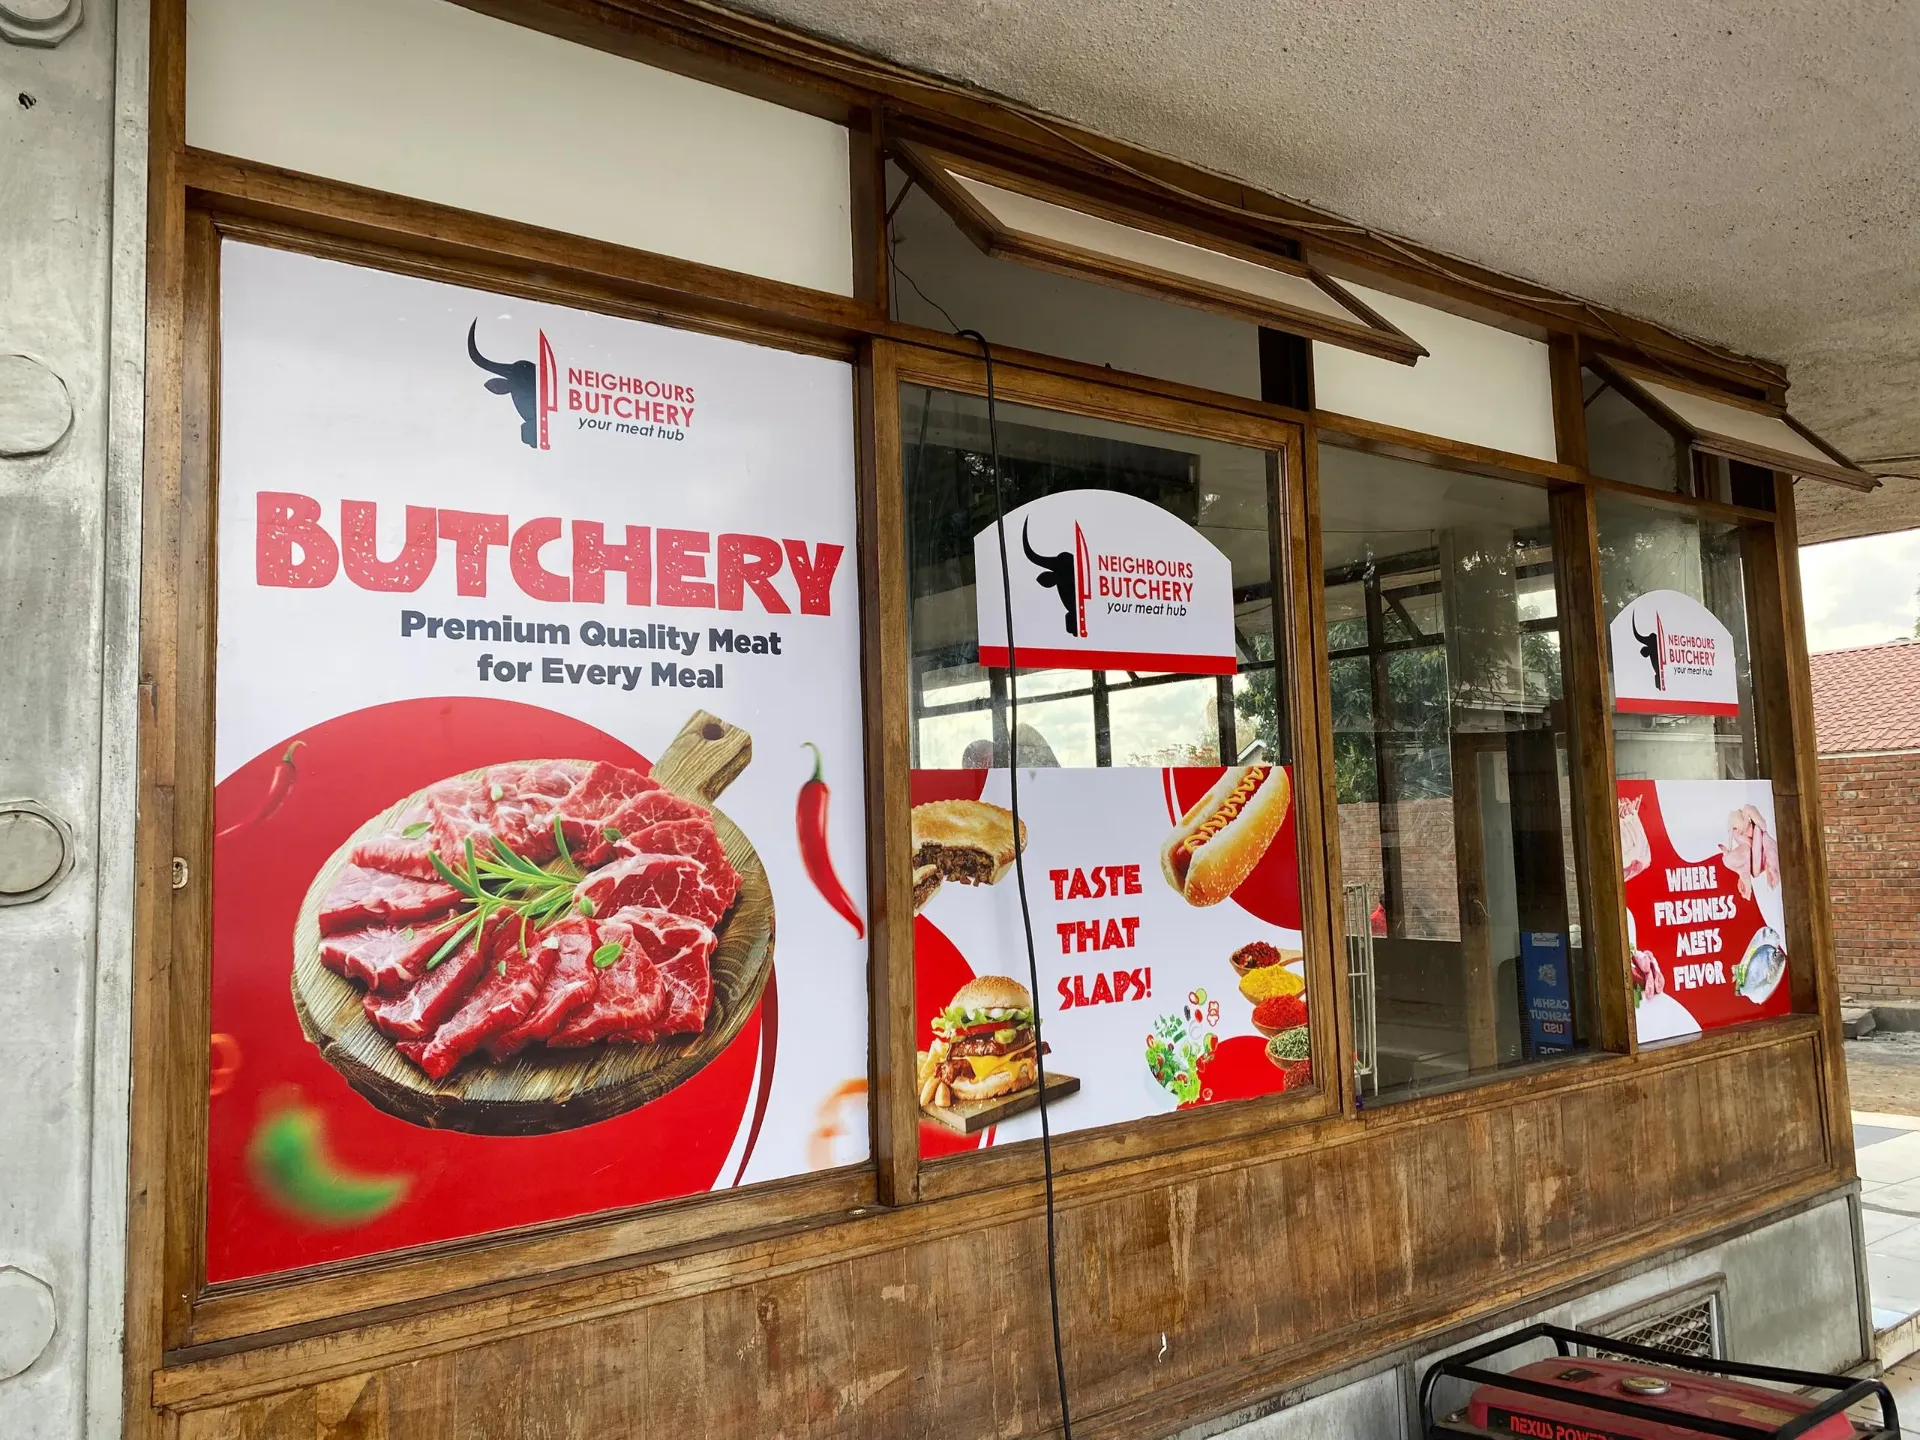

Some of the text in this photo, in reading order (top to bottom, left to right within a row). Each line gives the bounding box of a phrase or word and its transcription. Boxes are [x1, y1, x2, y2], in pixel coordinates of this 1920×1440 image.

[568, 367, 695, 404] NEIGHBOURS
[568, 388, 695, 428] BUTCHERY
[578, 417, 685, 441] your meat hub
[256, 491, 844, 617] BUTCHERY
[1098, 554, 1193, 579] NEIGHBOURS
[1099, 575, 1193, 602] BUTCHERY
[1107, 602, 1187, 616] your meat hub
[401, 610, 782, 656] Premium Quality Meat
[1668, 634, 1715, 649] NEIGHBOURS
[476, 653, 724, 691] for Every Meal
[1669, 648, 1715, 666] BUTCHERY
[1674, 667, 1712, 676] your meat hub
[1049, 864, 1142, 901] TASTE
[1665, 865, 1718, 892] WHERE
[1653, 894, 1737, 927] FRESHNESS
[1056, 916, 1140, 954] THAT
[1676, 928, 1723, 958] MEETS
[1057, 967, 1152, 1011] SLAPS!
[1673, 960, 1727, 991] FLAVOR
